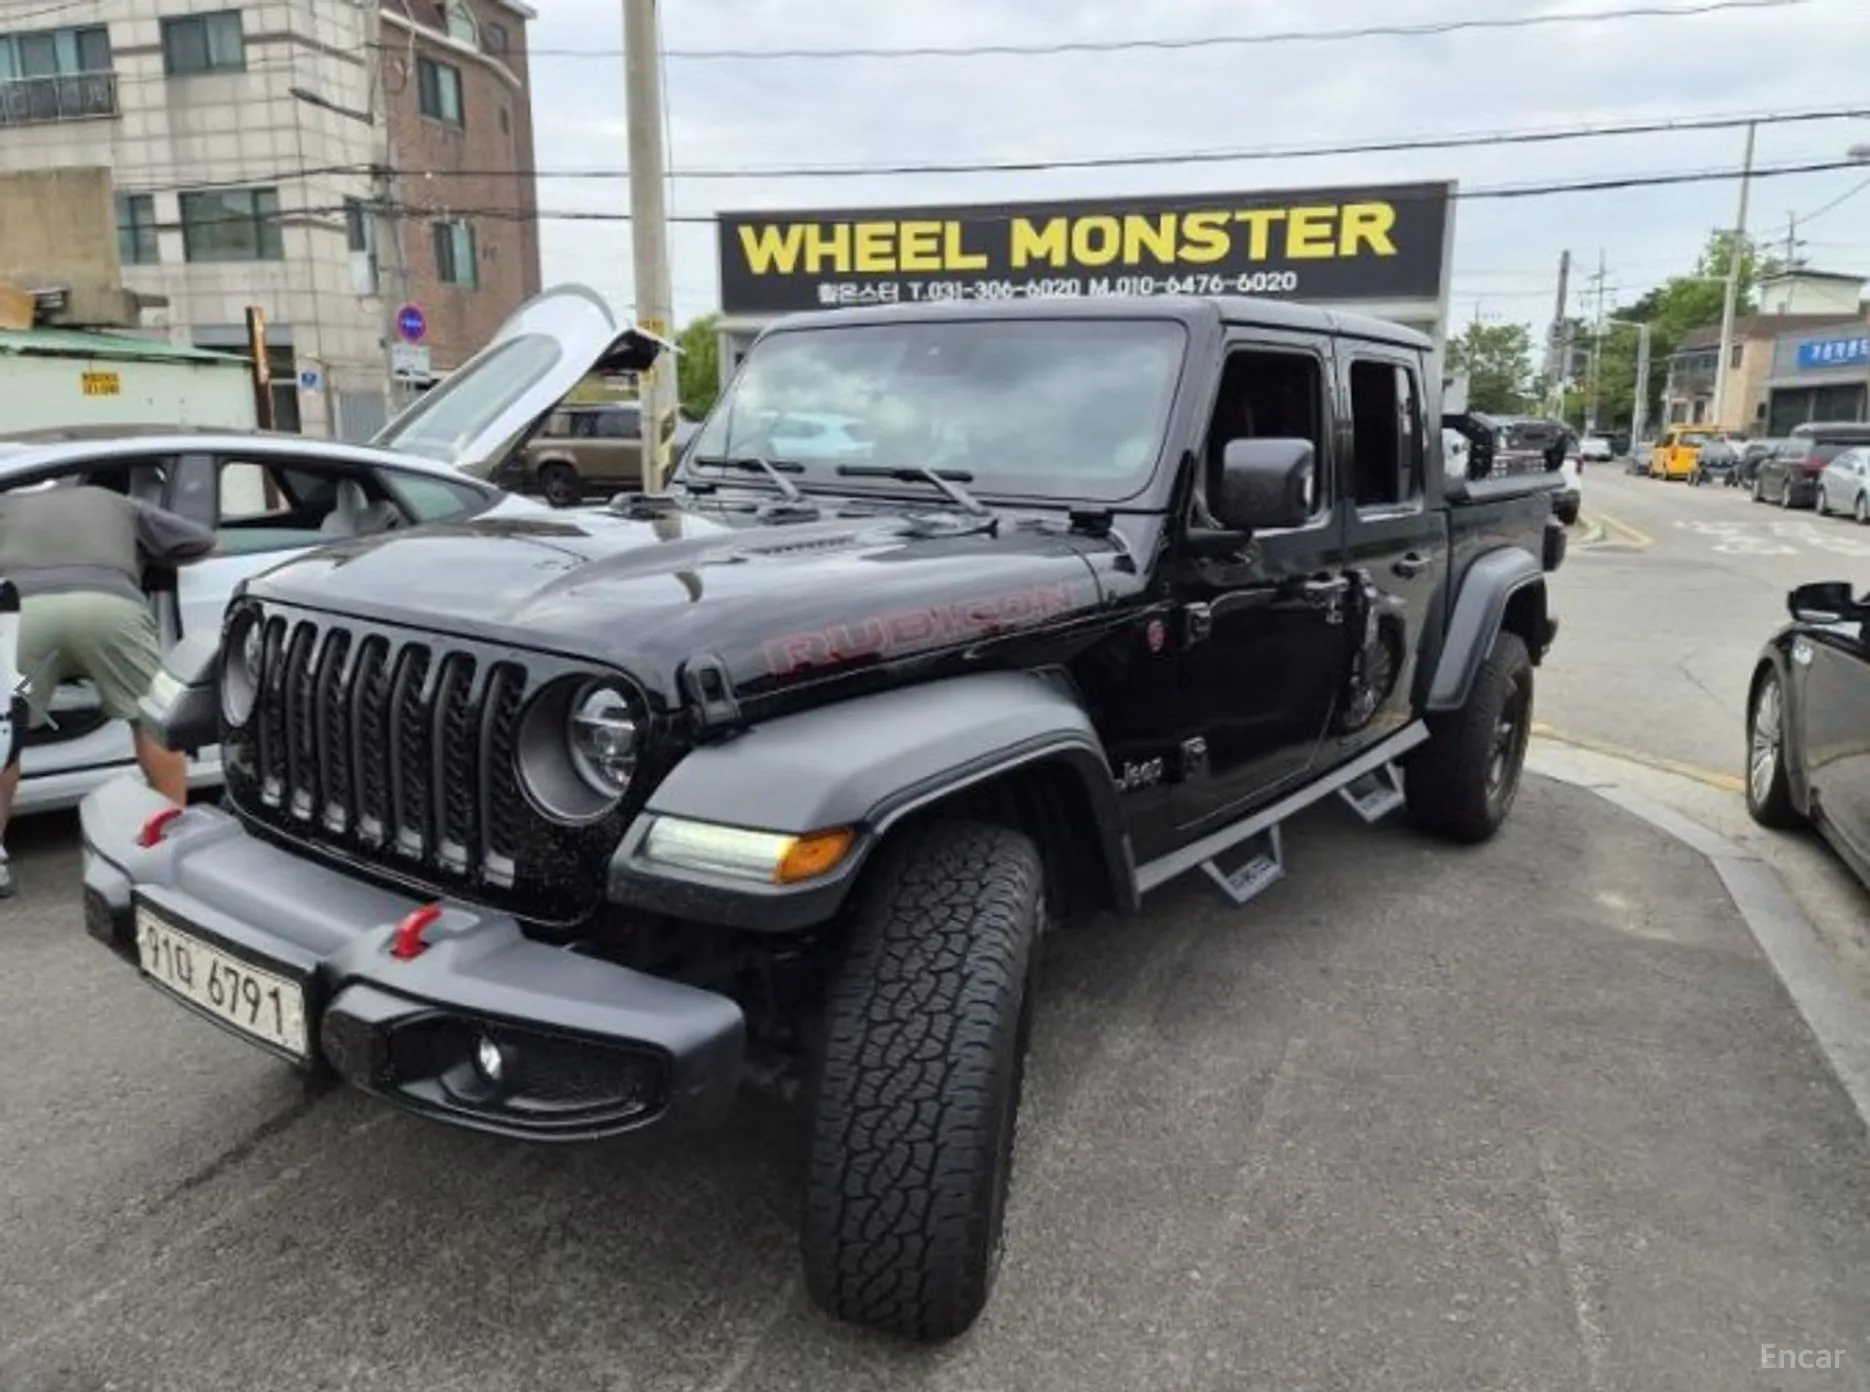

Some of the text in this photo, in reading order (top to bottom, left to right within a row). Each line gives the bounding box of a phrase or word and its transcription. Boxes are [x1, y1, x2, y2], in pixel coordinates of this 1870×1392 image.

[738, 202, 1397, 274] WHEEL MONSTER
[761, 584, 1074, 674] RUBICON
[207, 958, 284, 1036] 6791
